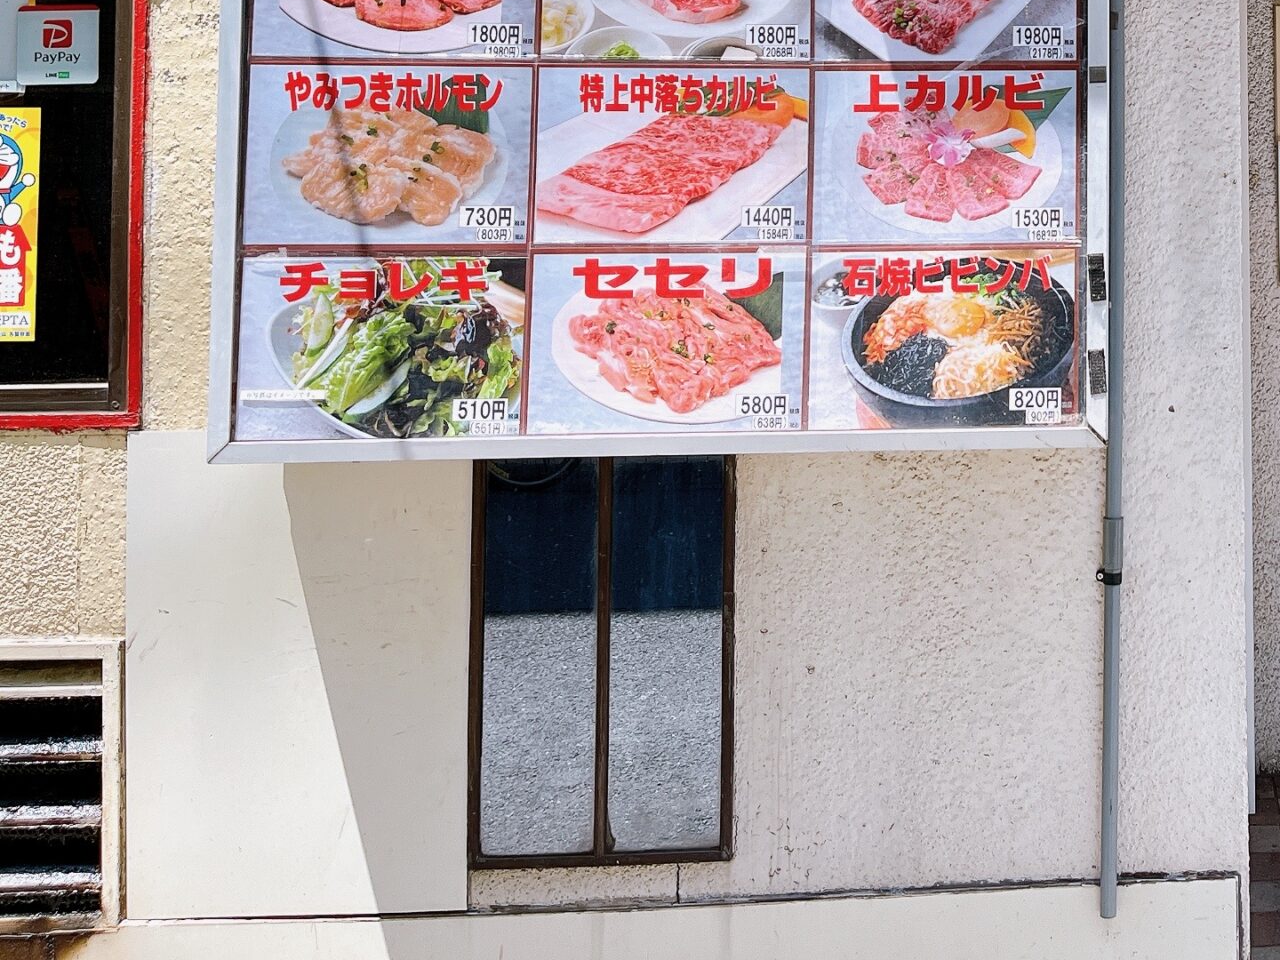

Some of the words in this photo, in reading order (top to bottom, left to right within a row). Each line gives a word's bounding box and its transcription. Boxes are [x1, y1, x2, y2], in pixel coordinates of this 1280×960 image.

[472, 25, 519, 44] 1800円
[749, 26, 796, 45] 1880円
[1016, 28, 1061, 45] 1980円
[34, 52, 81, 63] PayPay
[762, 47, 797, 58] (2068円)
[1029, 46, 1063, 59] (2178円)
[285, 71, 504, 113] やみつきホルモン
[580, 73, 777, 113] 特上中落ちカルビ
[854, 73, 1044, 112] 上カルビ
[465, 208, 511, 226] 730円
[745, 208, 791, 226] 1440円
[1015, 210, 1060, 227] 1530円
[477, 228, 511, 240] (803円)
[757, 228, 793, 240] (1584円)
[280, 260, 488, 302] チョレギ
[573, 257, 773, 298] セセリ
[842, 255, 1051, 297] 石焼ビビンバ
[741, 396, 787, 415] 580円
[1015, 390, 1058, 408] 820円
[458, 401, 505, 419] 510円
[470, 422, 505, 434] (561円)
[752, 417, 787, 429] (638円)
